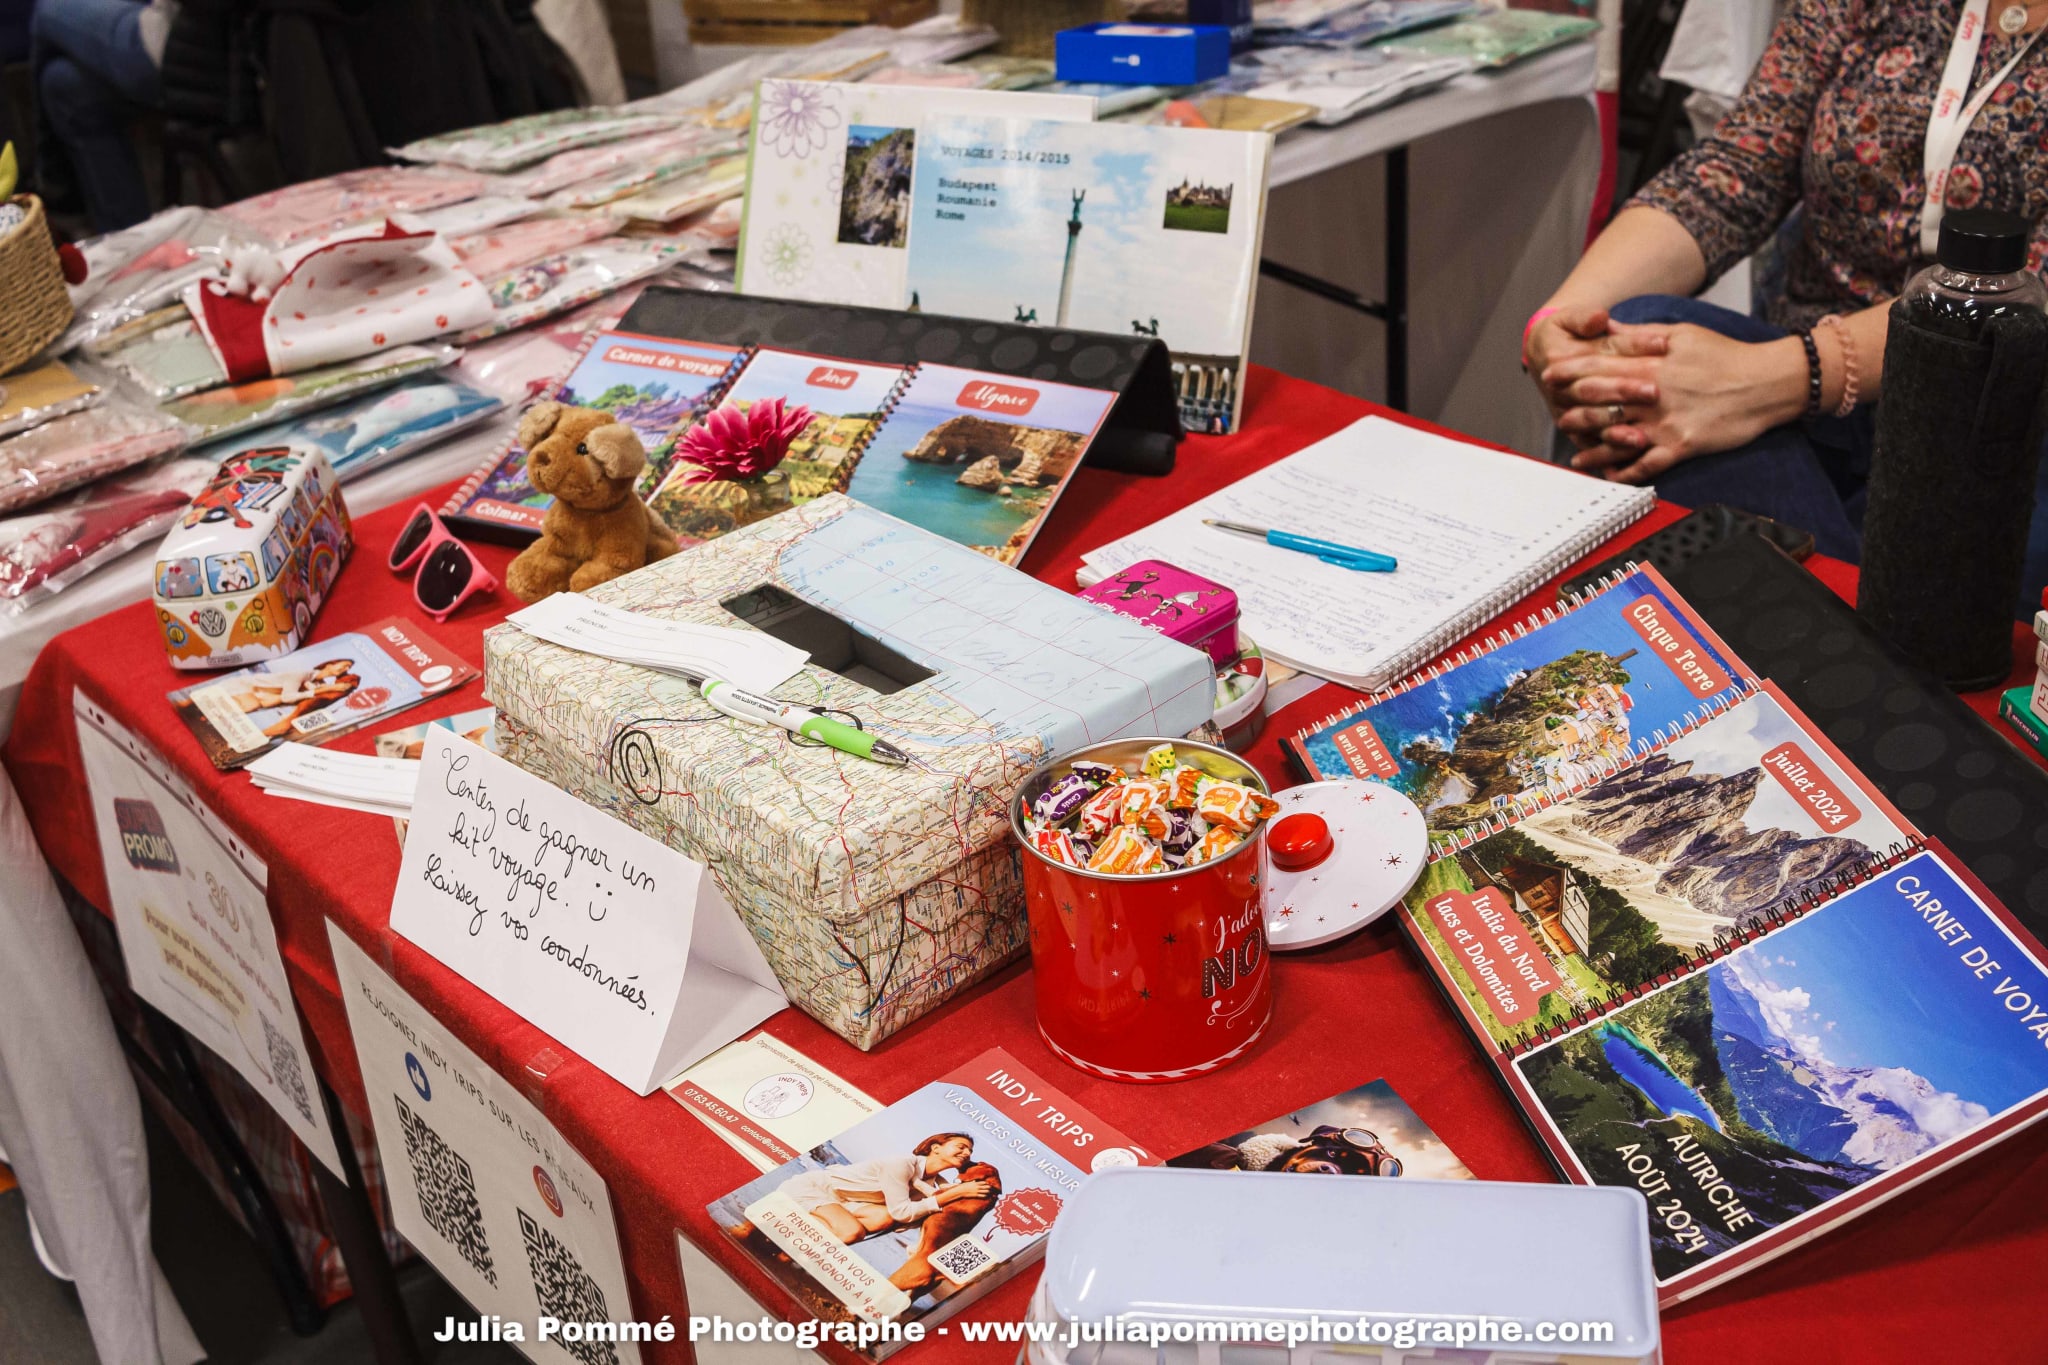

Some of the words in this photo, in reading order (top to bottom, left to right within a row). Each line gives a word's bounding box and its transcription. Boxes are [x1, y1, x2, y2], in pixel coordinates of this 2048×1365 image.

[940, 146, 994, 159] VOYAGES
[1001, 149, 1070, 165] 2014/2015
[937, 193, 997, 207] Roumanie
[938, 177, 997, 192] Budapest
[935, 208, 966, 221] Rome
[608, 346, 656, 368] Carnet
[658, 354, 677, 370] de
[677, 358, 727, 377] voyage
[971, 382, 1030, 409] Algarve
[475, 501, 528, 523] Colmar
[381, 625, 411, 651] INDY
[402, 642, 433, 668] TRIPS
[1633, 603, 1679, 653] Cinque
[1675, 649, 1715, 691] Terre
[1356, 725, 1368, 738] du
[1363, 737, 1377, 749] 11
[1371, 749, 1383, 761] au
[1378, 760, 1392, 771] 17
[2011, 713, 2040, 742] MICHELIN
[1337, 734, 1358, 755] avril
[1350, 754, 1370, 775] 2024
[1764, 750, 1816, 793] juillet
[1806, 789, 1849, 825] 2024
[448, 812, 480, 857] kit
[506, 798, 533, 832] de
[534, 821, 613, 878] gagner
[621, 860, 656, 892] un
[124, 833, 176, 864] PROMO
[205, 871, 241, 933] 30
[424, 853, 488, 937] Laissez
[500, 911, 528, 941] vos
[1435, 897, 1462, 929] lacs
[1454, 929, 1475, 944] et
[1472, 895, 1505, 934] Italie
[1498, 934, 1518, 955] du
[1511, 952, 1550, 992] Nord
[1464, 941, 1519, 1014] Dolomites
[1895, 875, 1973, 947] CARNET
[1960, 945, 2002, 980] DE
[1993, 976, 2048, 1050] VOYA
[360, 981, 418, 1048] REJOIGNEZ
[420, 1040, 449, 1074] INDY
[453, 1068, 485, 1106] TRIPS
[489, 1100, 515, 1132] SUR
[518, 1125, 541, 1154] LES
[777, 1076, 797, 1085] INDY
[797, 1080, 809, 1097] TRIPS
[684, 1088, 740, 1124] 07.63.45.60.47
[944, 1089, 1011, 1141] VACANCES
[1009, 1138, 1038, 1161] SUR
[985, 1068, 1042, 1107] INDY
[1037, 1105, 1094, 1147] TRIPS
[1616, 1143, 1671, 1197] AOÛT
[1656, 1198, 1709, 1255] 2024
[1667, 1133, 1755, 1232] AUTRICHE
[1009, 1208, 1032, 1226] gratuit
[1011, 1198, 1049, 1227] Rendez-vous
[761, 1211, 775, 1222] ET
[773, 1220, 795, 1239] VOS
[792, 1238, 856, 1291] COMPAGNONS
[863, 1297, 872, 1305] 4
[821, 1241, 848, 1265] POUR
[848, 1263, 875, 1287] VOUS
